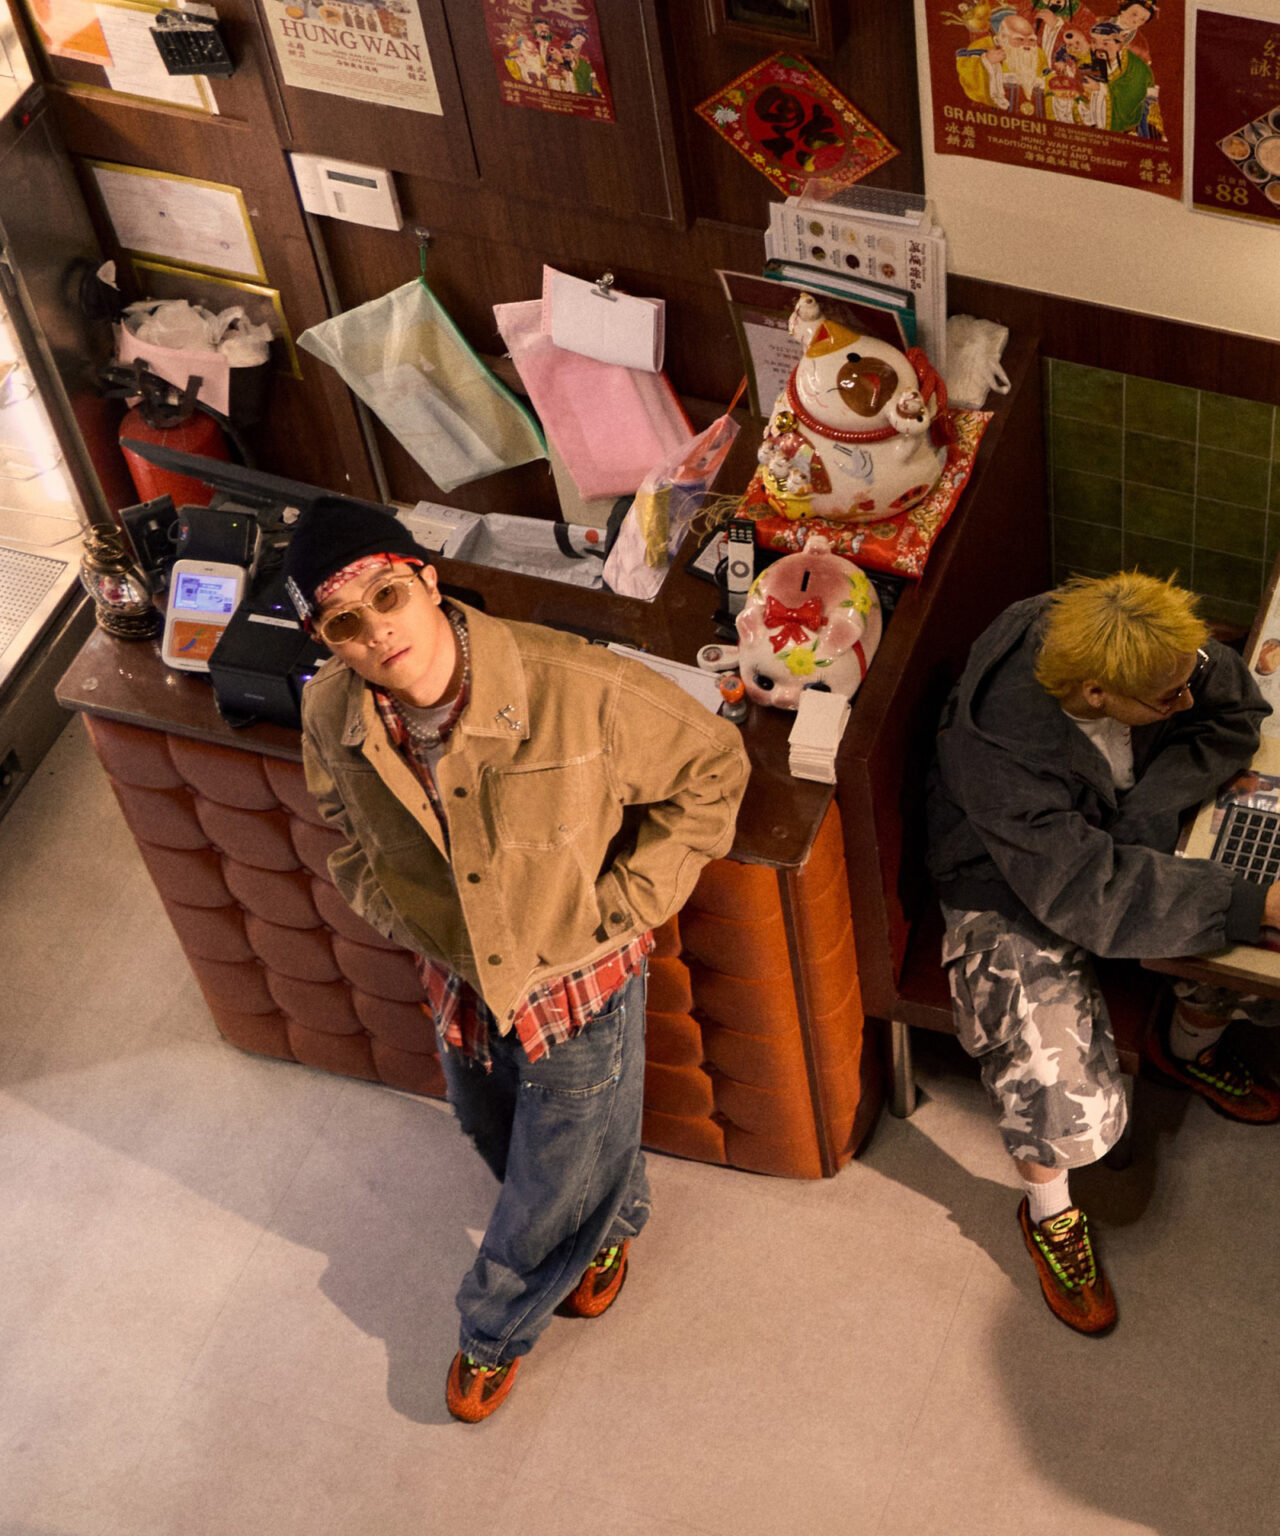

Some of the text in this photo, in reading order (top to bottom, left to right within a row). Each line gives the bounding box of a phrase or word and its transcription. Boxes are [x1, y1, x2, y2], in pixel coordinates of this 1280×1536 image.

[280, 18, 358, 50] HUNG
[359, 34, 422, 63] WAN
[943, 105, 1047, 136] GRAND OPEN!
[987, 136, 1128, 168] TRADITIONAL CAFE AND DESSERT
[1021, 136, 1093, 155] HUNG WAN CAFE
